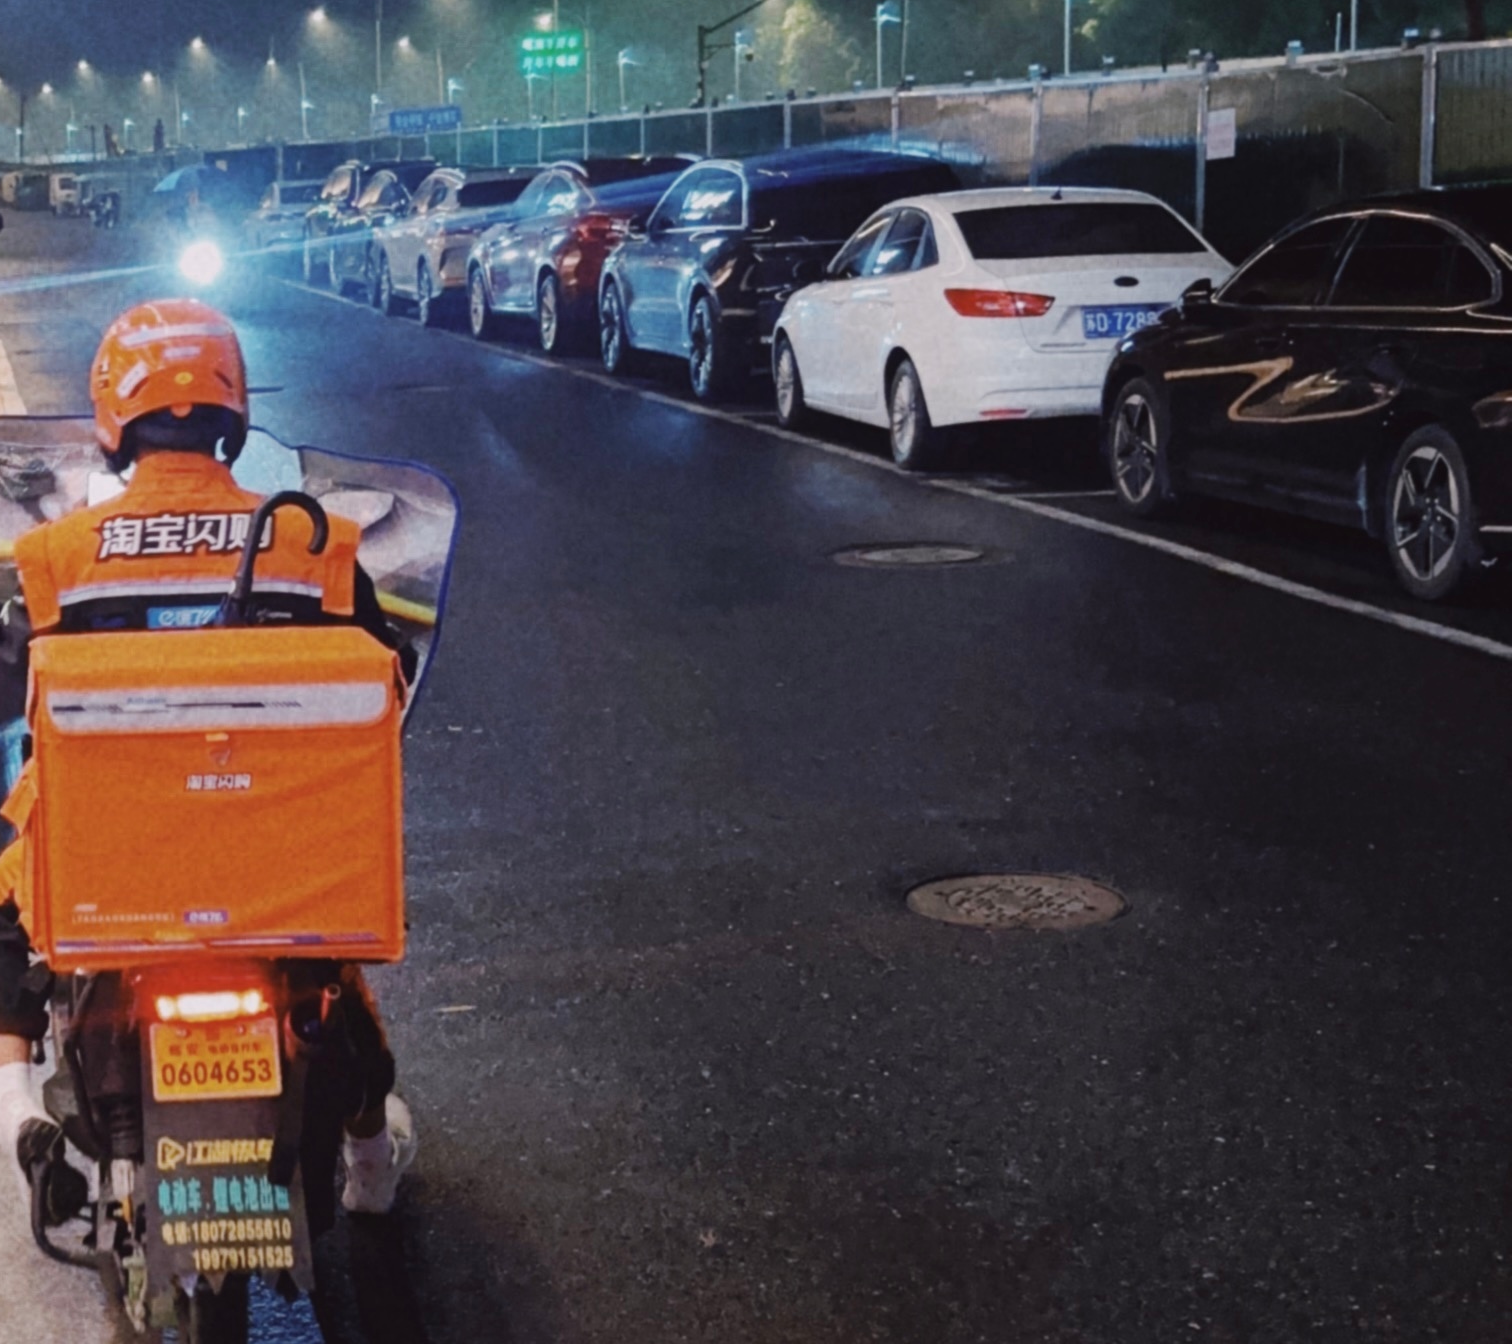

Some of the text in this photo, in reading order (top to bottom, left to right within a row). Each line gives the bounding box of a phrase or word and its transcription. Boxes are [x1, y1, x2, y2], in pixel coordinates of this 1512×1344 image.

[97, 512, 274, 560] 淘宝闪购
[185, 773, 252, 791] 淘宝闪购
[161, 1058, 272, 1087] 0604653
